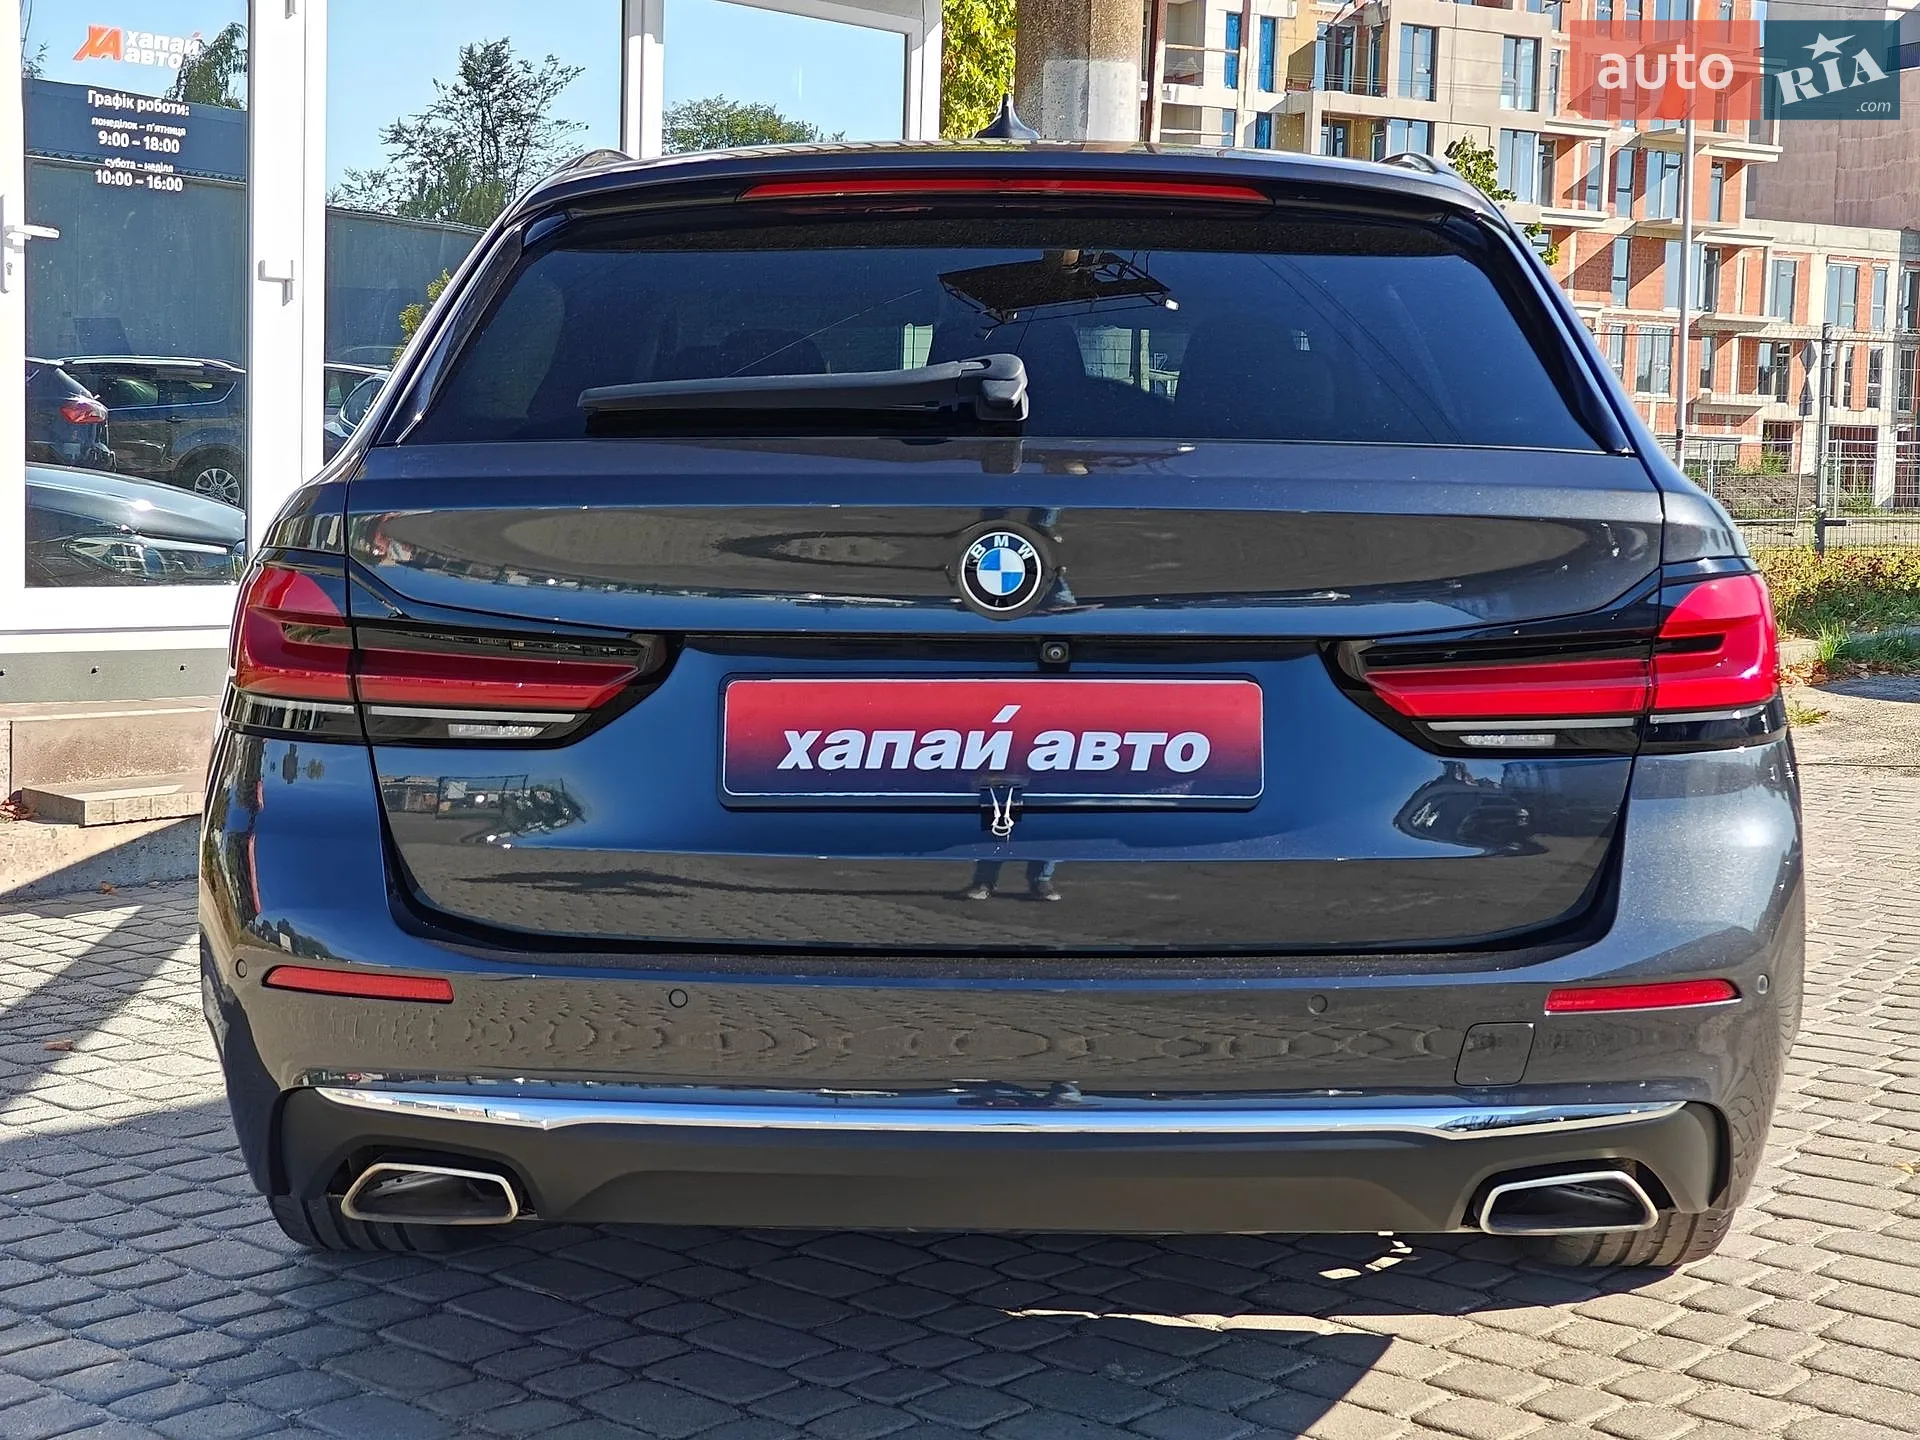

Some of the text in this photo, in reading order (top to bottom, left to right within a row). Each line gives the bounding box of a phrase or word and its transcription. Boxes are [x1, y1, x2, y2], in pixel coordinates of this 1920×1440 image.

[124, 47, 184, 69] авто
[88, 90, 190, 116] Графік роботи:
[92, 117, 137, 131] понеділок
[98, 131, 129, 148] 9:00
[143, 136, 180, 154] 18:00
[104, 157, 136, 171] субота
[144, 161, 173, 174] неділя
[95, 170, 132, 187] 10:00
[147, 175, 183, 192] 16:00
[970, 536, 1034, 560] BMW
[777, 704, 1211, 773] хапай авто
